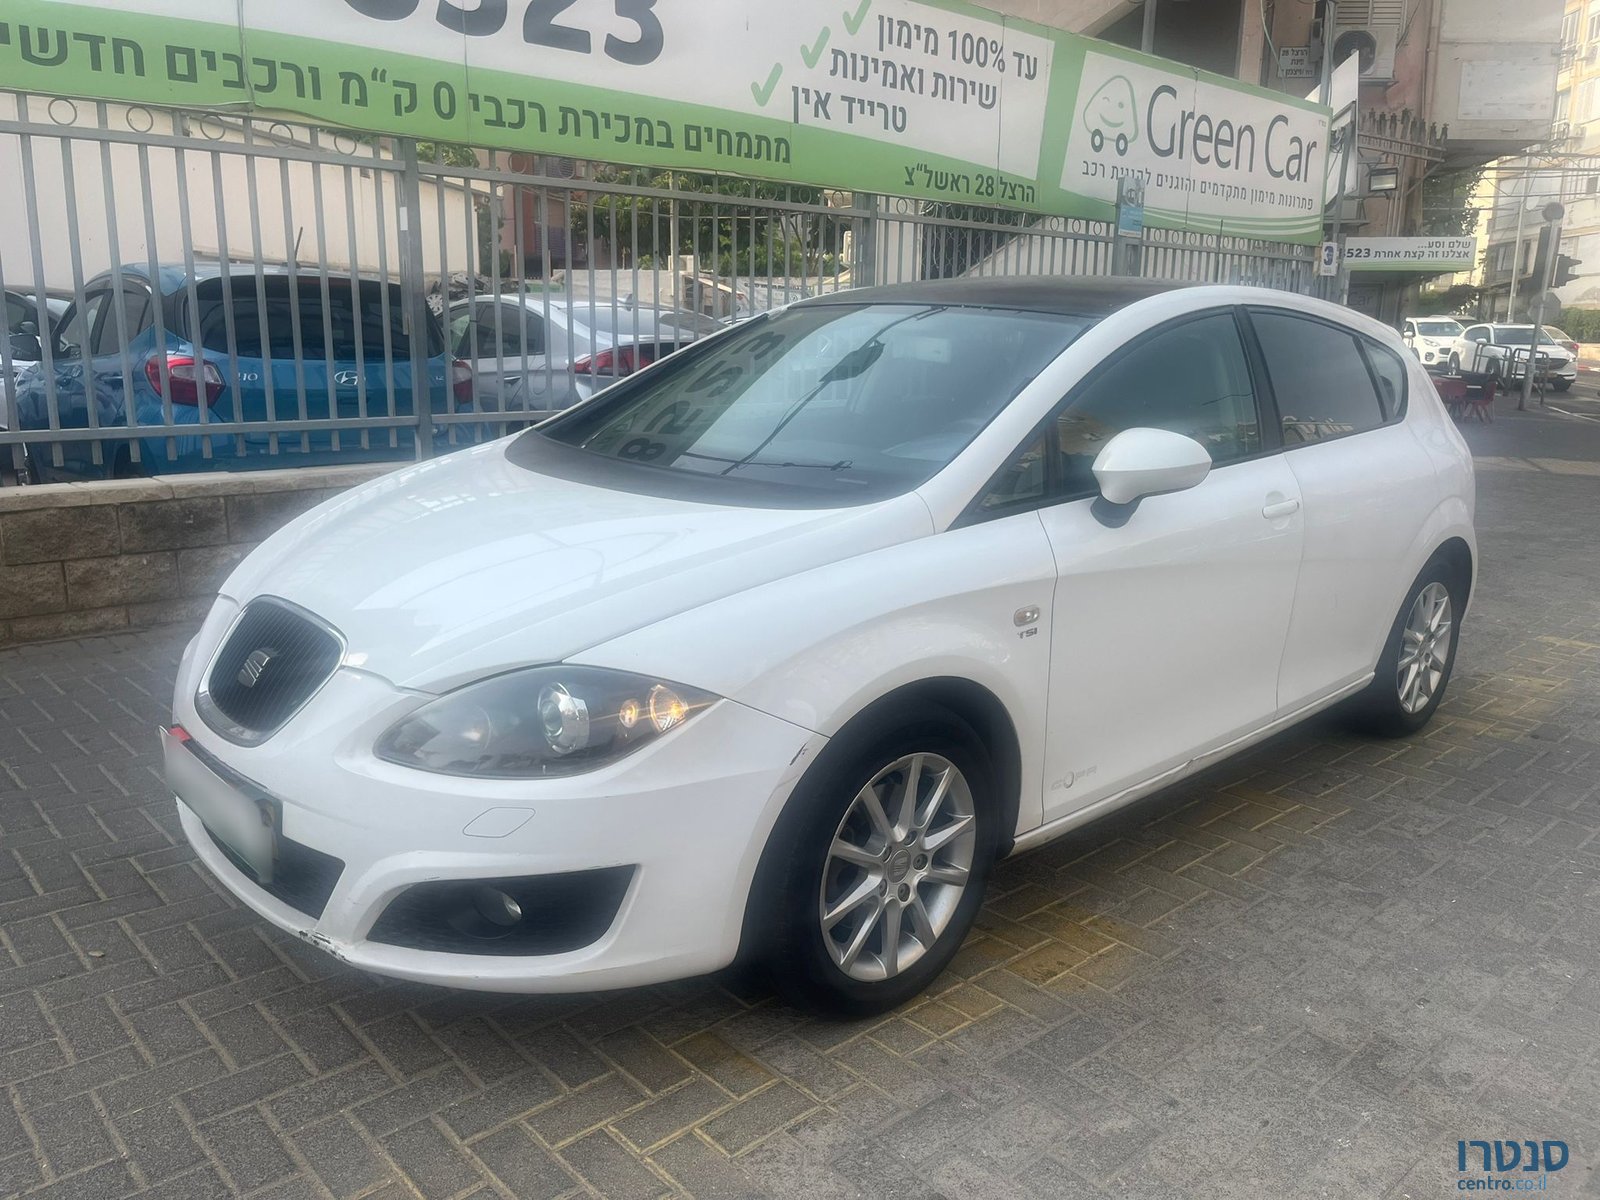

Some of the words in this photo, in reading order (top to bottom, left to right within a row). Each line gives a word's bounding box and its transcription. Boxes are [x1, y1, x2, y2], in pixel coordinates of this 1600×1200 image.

[877, 14, 939, 57] מימון
[948, 29, 1006, 73] 100%
[165, 44, 322, 101] ורכבים
[829, 48, 924, 95] ואמינות
[1012, 51, 1038, 81] עד
[433, 81, 457, 121] 0
[931, 71, 997, 110] שירות
[468, 93, 547, 133] רכבי
[791, 85, 832, 125] אין
[840, 94, 907, 133] טרייד
[558, 105, 675, 149] במכירת
[1146, 84, 1256, 173] Green
[1264, 114, 1318, 184] Car
[684, 124, 791, 165] מתמחים
[1082, 160, 1106, 179] רכב
[1156, 173, 1196, 193] והוגנים
[975, 173, 995, 198] 28
[999, 177, 1036, 203] הרצל
[1200, 180, 1247, 202] מתקדמים
[1250, 188, 1275, 206] מימון
[1277, 192, 1314, 211] פתרונות
[1374, 250, 1401, 259] אחרת
[1404, 250, 1425, 260] קצת
[1428, 250, 1439, 258] זה
[1441, 249, 1470, 259] אצלנו
[1448, 240, 1471, 249] שלם
[1017, 627, 1038, 639] TSI
